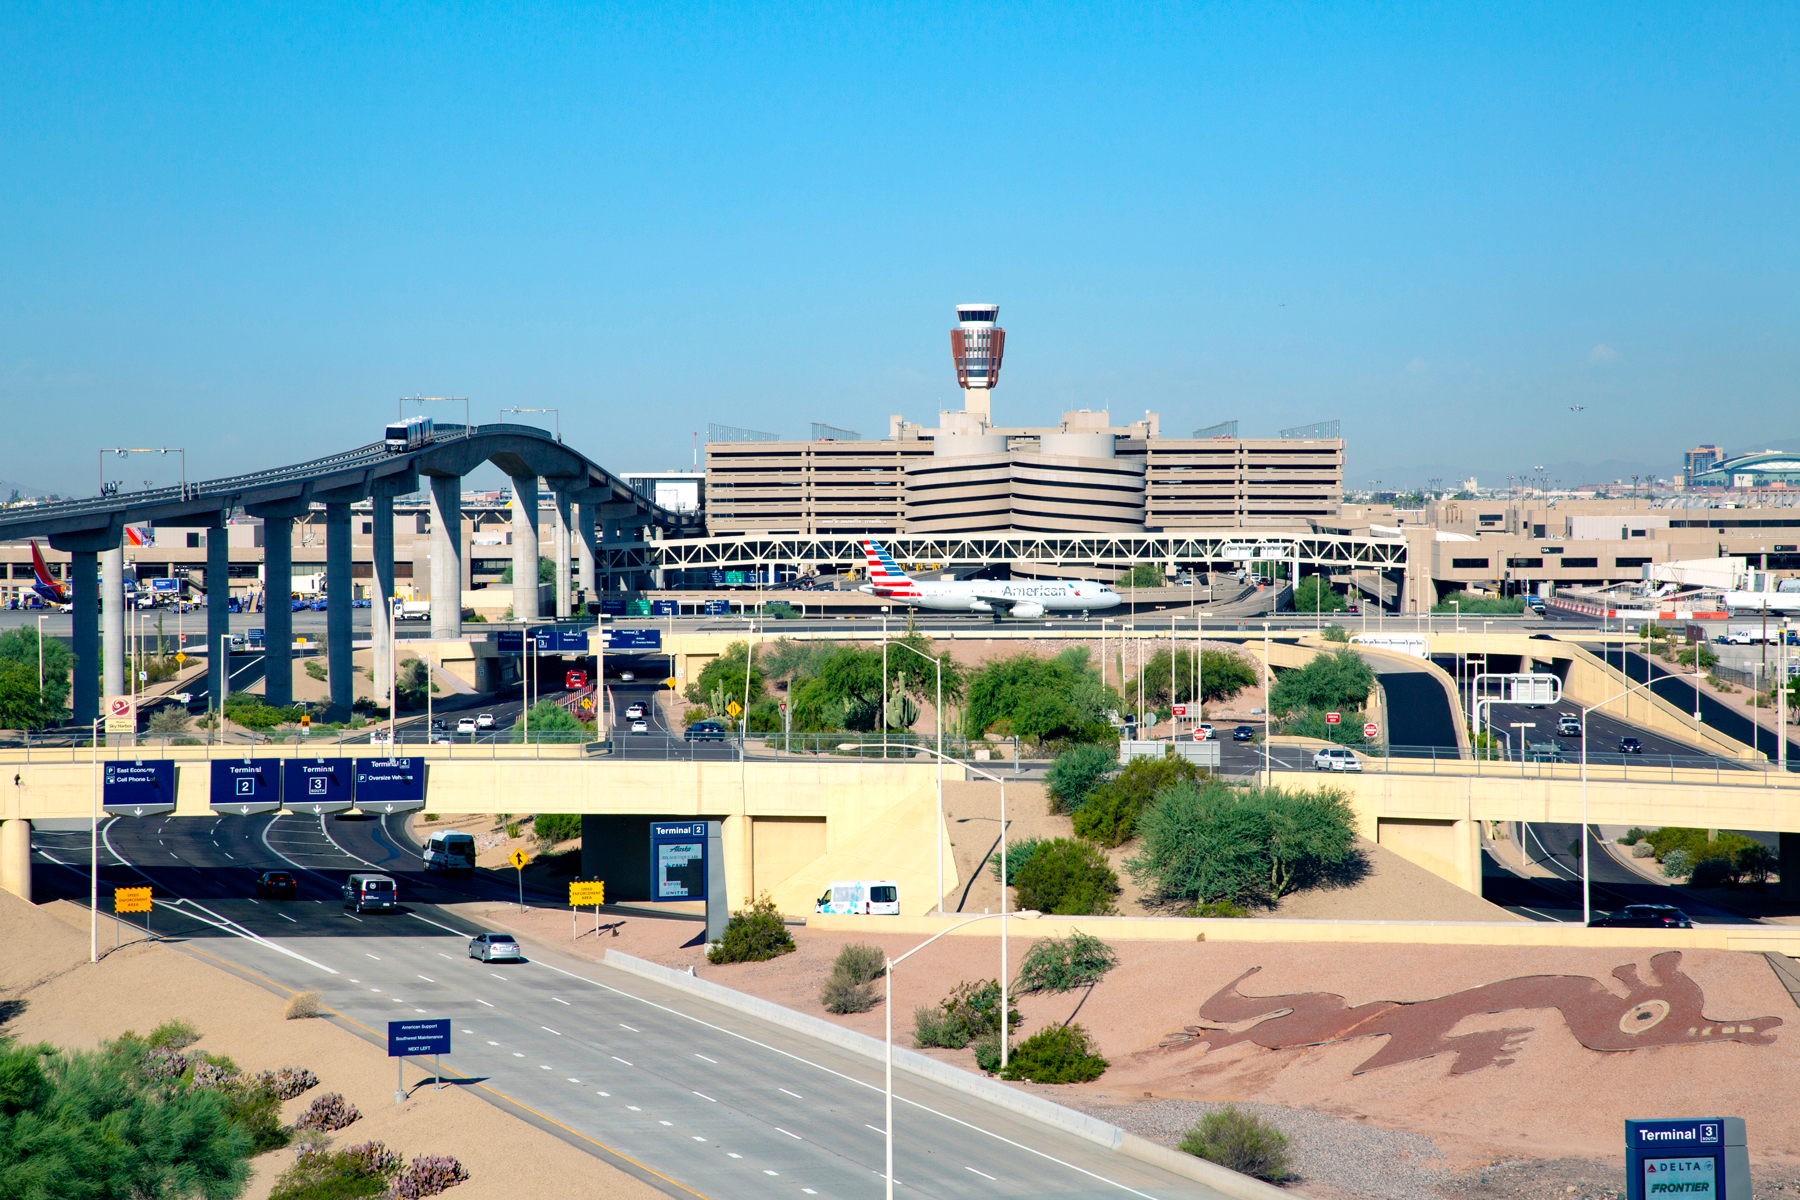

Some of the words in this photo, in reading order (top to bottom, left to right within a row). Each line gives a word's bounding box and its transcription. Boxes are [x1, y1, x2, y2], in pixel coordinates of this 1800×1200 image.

[1002, 584, 1066, 596] American
[242, 782, 249, 791] 2
[314, 779, 322, 788] 3
[1639, 1128, 1696, 1140] Terminal
[1705, 1126, 1713, 1136] 3
[1660, 1162, 1701, 1171] DELTA
[1651, 1183, 1709, 1193] FRONTIER
